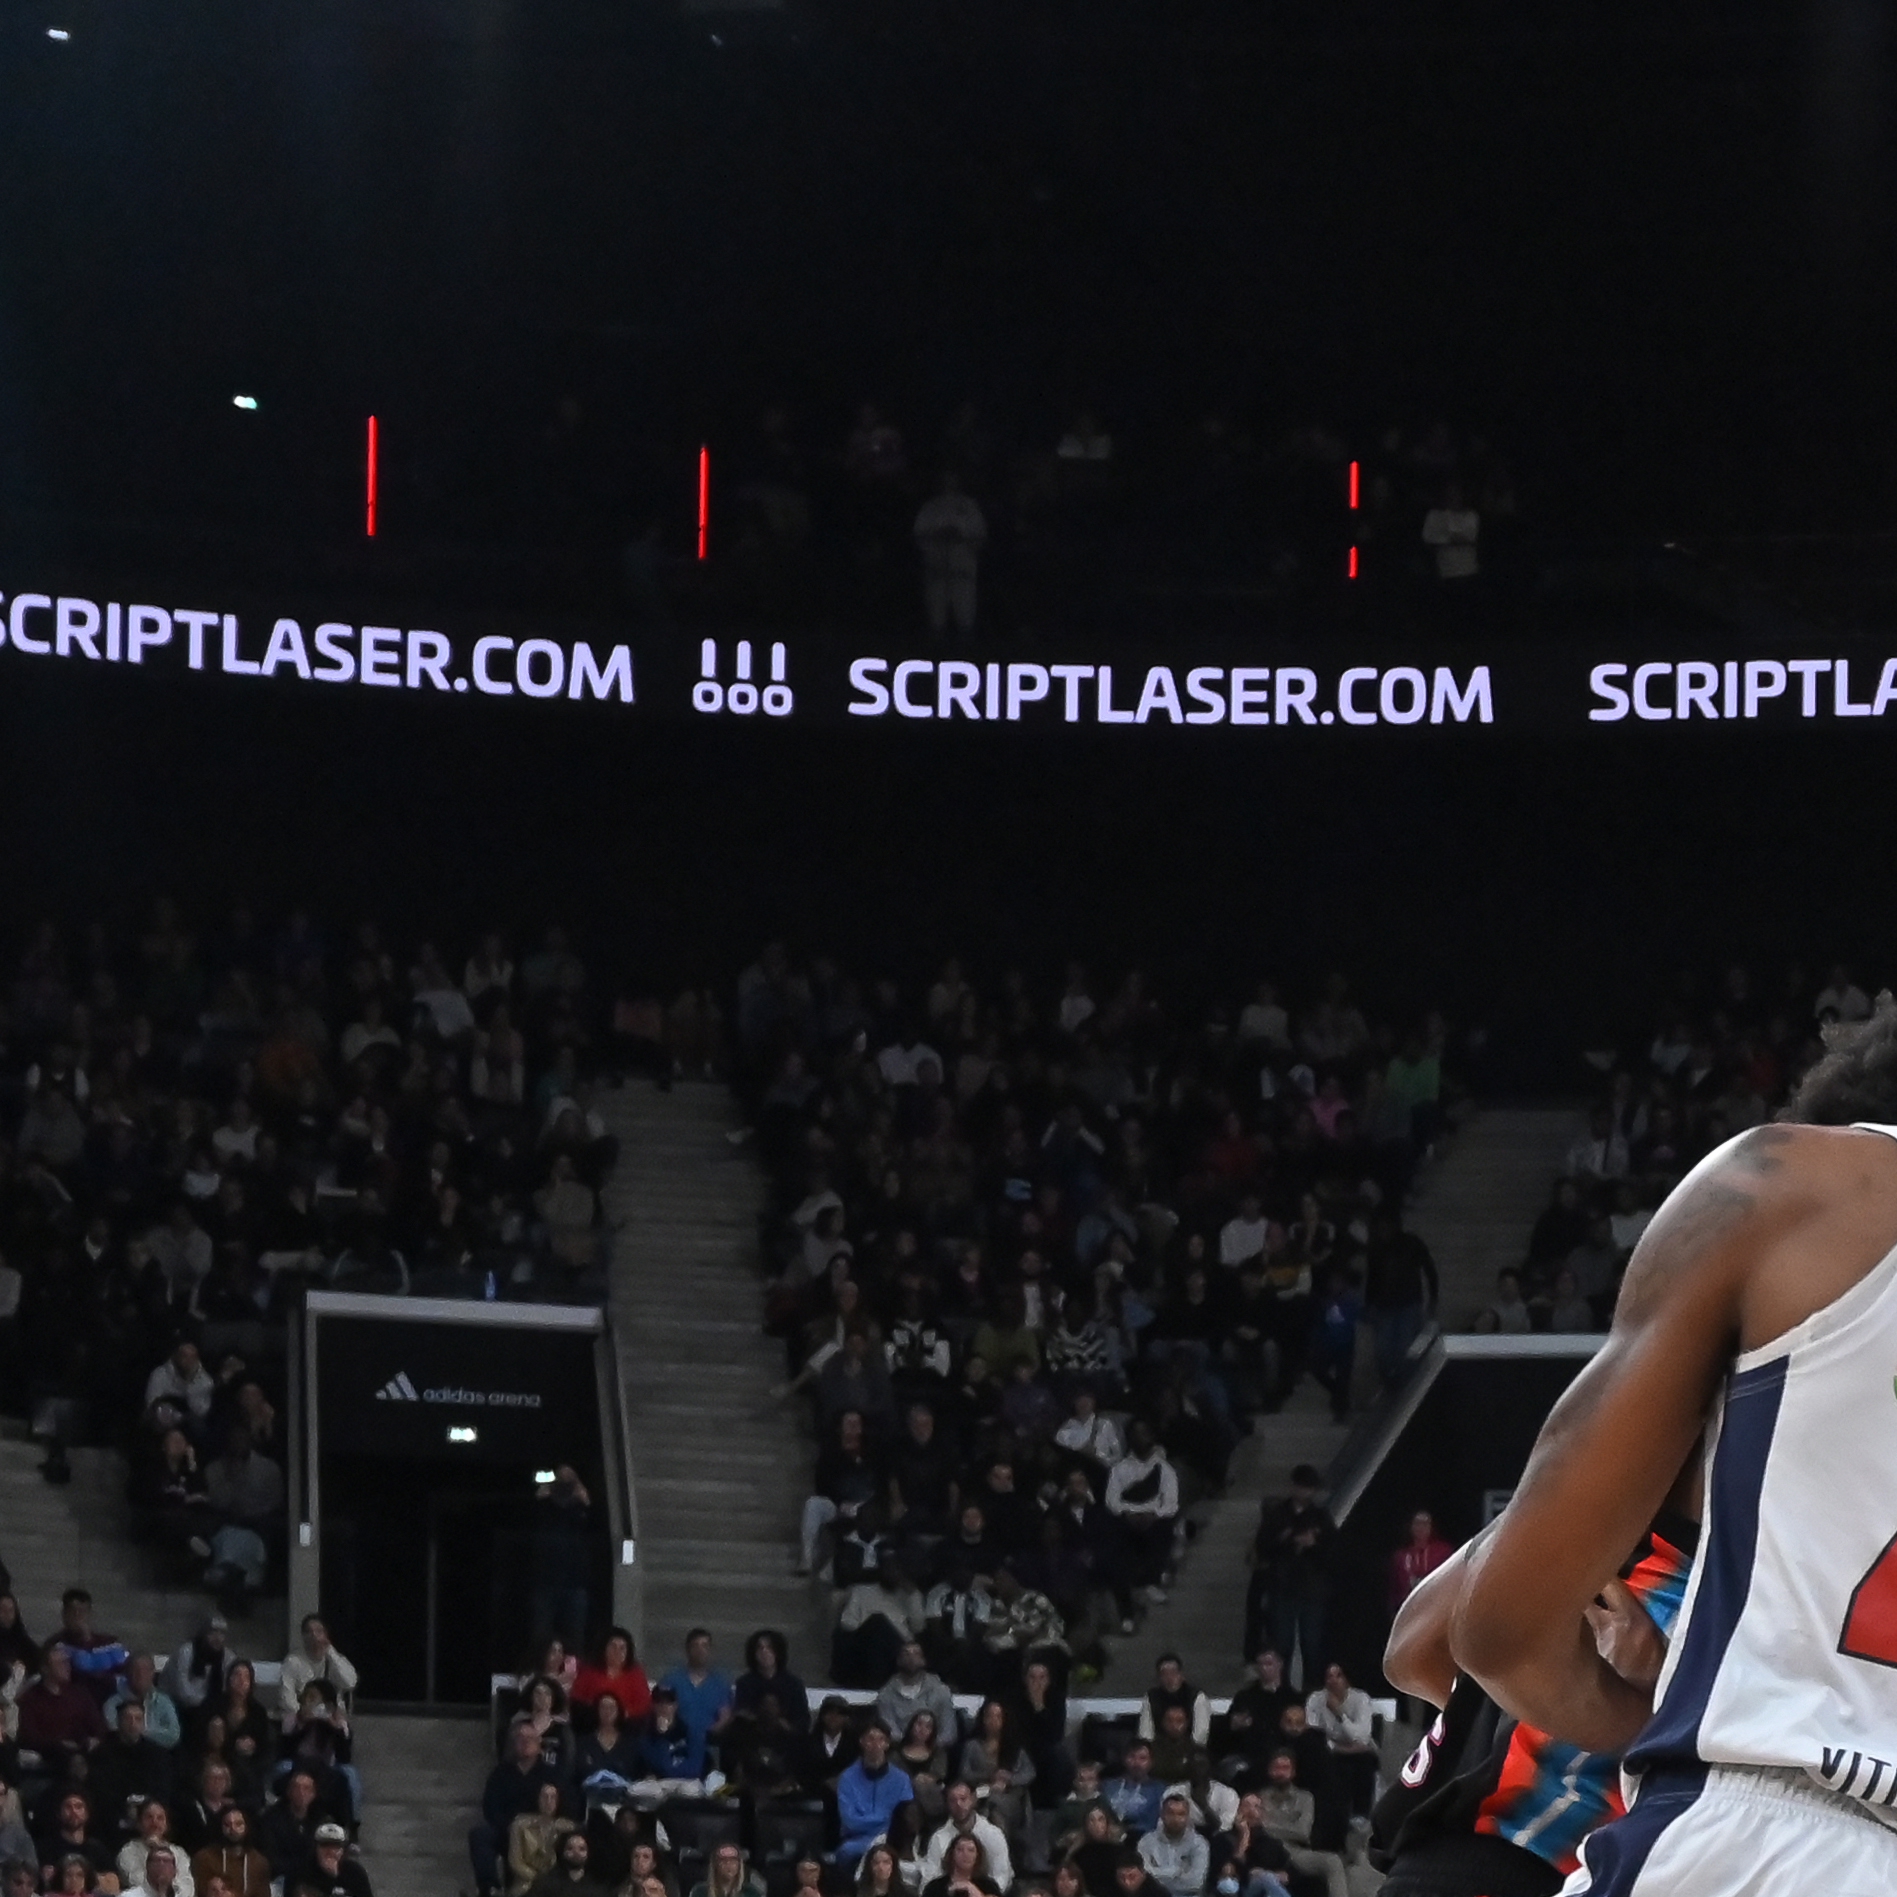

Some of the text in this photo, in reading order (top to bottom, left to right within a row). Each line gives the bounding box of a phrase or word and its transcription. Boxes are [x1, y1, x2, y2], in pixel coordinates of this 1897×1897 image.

[0, 592, 633, 703] CRIPTLASER.COM
[848, 658, 1493, 724] SCRIPTLASER.COM
[422, 1386, 541, 1408] adidas arena
